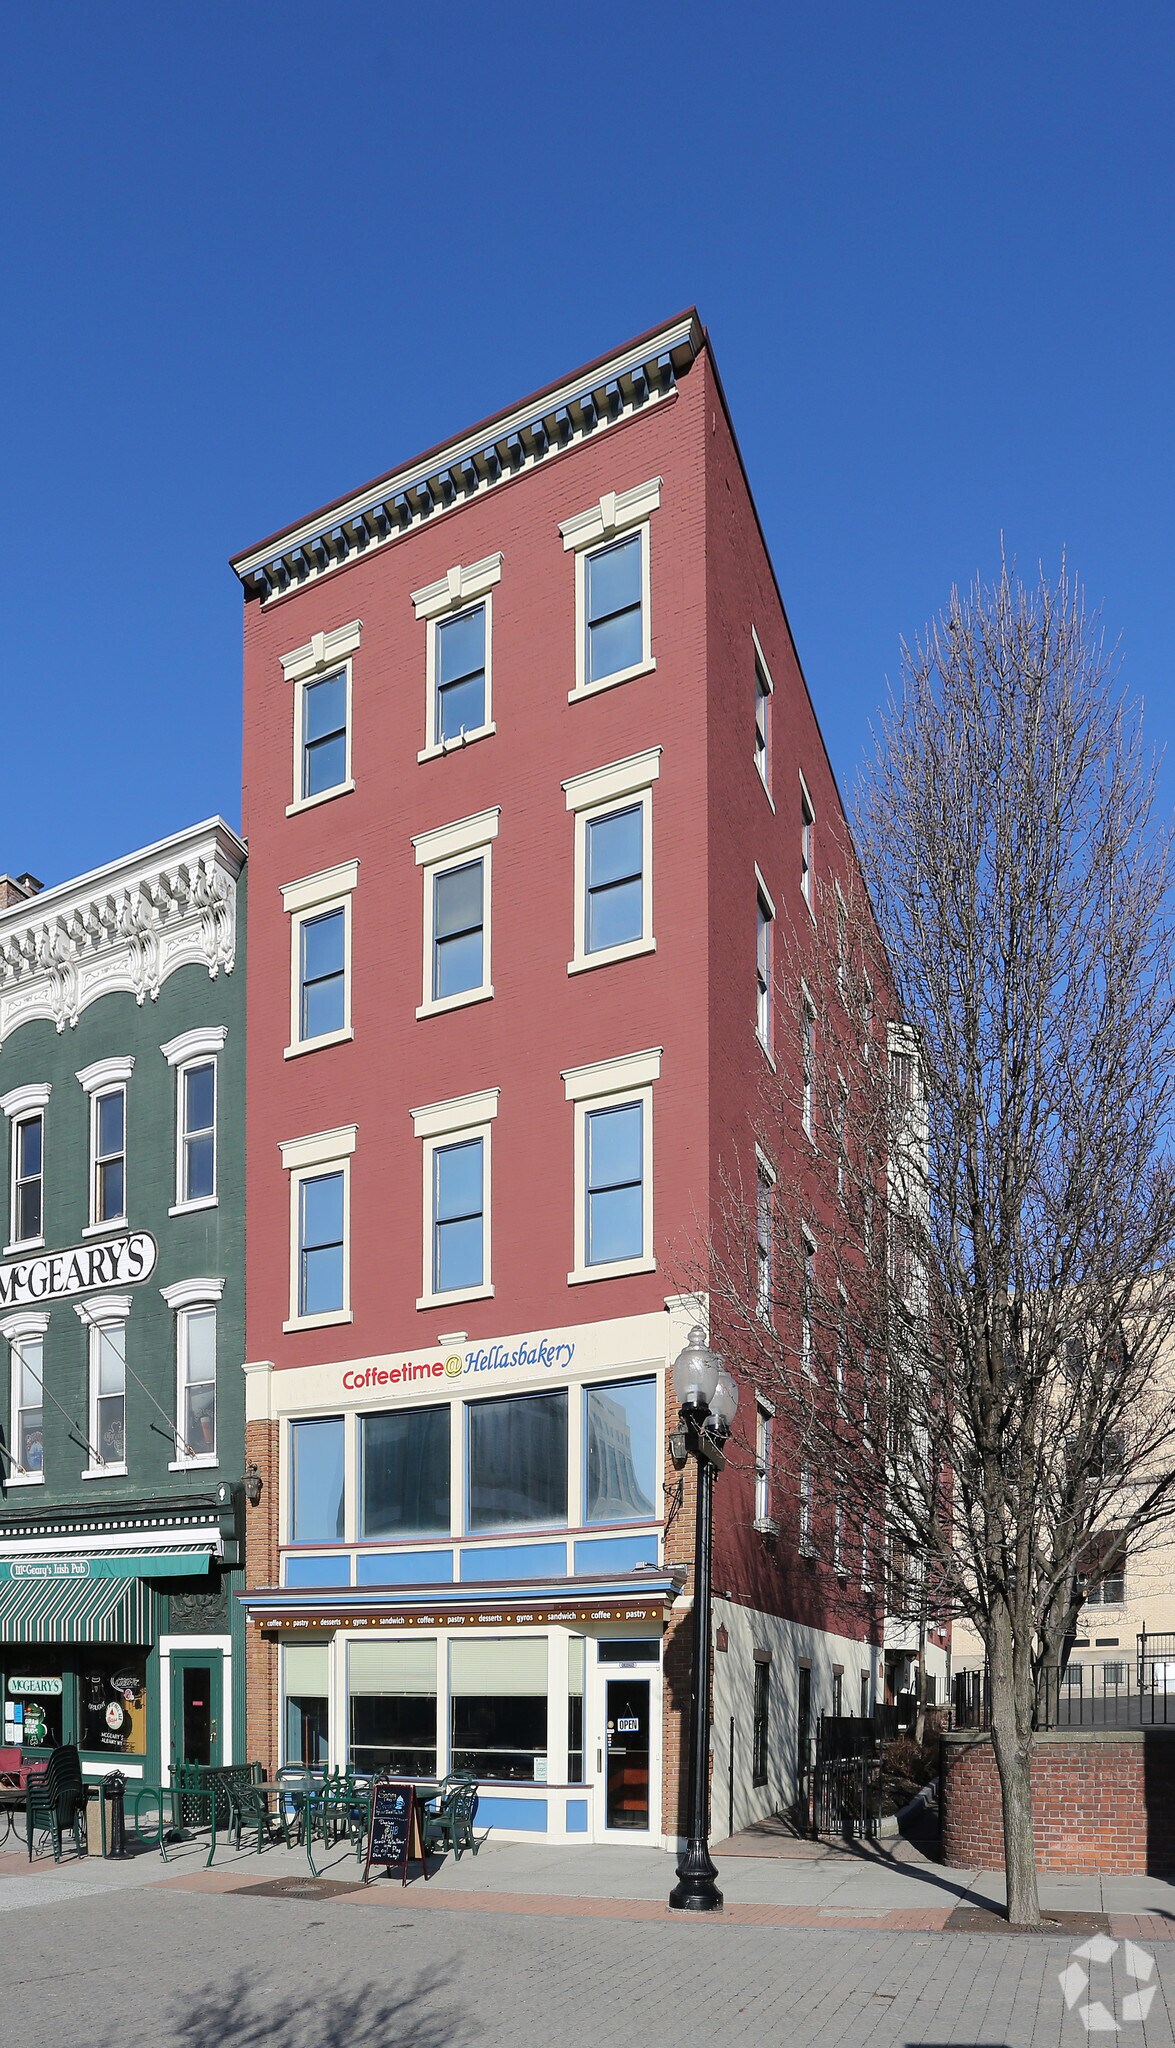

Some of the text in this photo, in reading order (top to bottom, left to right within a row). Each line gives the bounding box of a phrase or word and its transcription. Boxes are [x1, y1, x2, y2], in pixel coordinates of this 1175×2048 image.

[15, 1562, 86, 1578] McGeary's Irish Pub
[293, 1619, 309, 1628] pastry
[320, 1618, 341, 1627] desserts
[352, 1618, 368, 1628] gyros
[379, 1616, 405, 1625] sandwich
[417, 1615, 435, 1624] coffee
[447, 1615, 466, 1625] pastry
[478, 1614, 503, 1623] desserts
[516, 1613, 534, 1623] gyros
[547, 1611, 577, 1621] sandwich
[590, 1610, 611, 1620] coffee
[625, 1609, 647, 1619] pastry
[619, 1719, 638, 1730] OPEN
